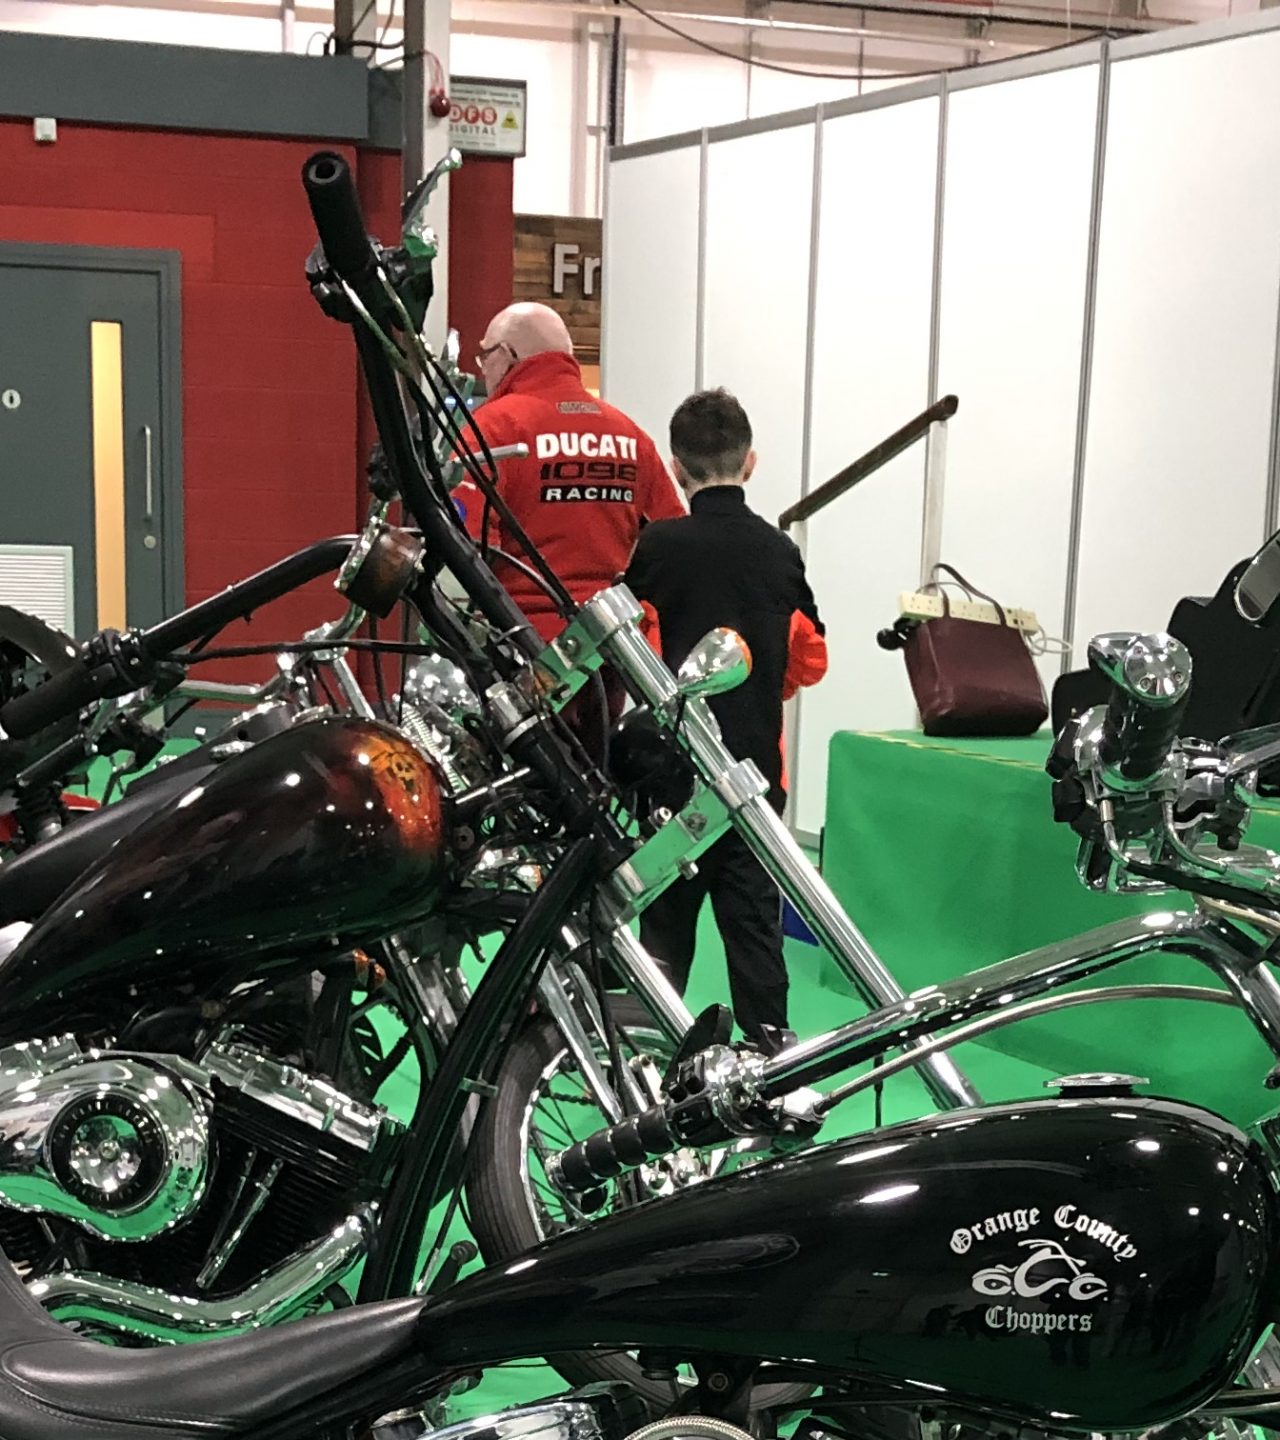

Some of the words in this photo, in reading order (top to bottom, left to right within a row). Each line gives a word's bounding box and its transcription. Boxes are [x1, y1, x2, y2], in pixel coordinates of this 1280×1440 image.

[536, 432, 638, 461] DUCATI
[545, 486, 633, 502] RACING
[949, 1207, 1041, 1255] Orange
[1053, 1204, 1138, 1263] County
[984, 1304, 1094, 1335] Choppers
